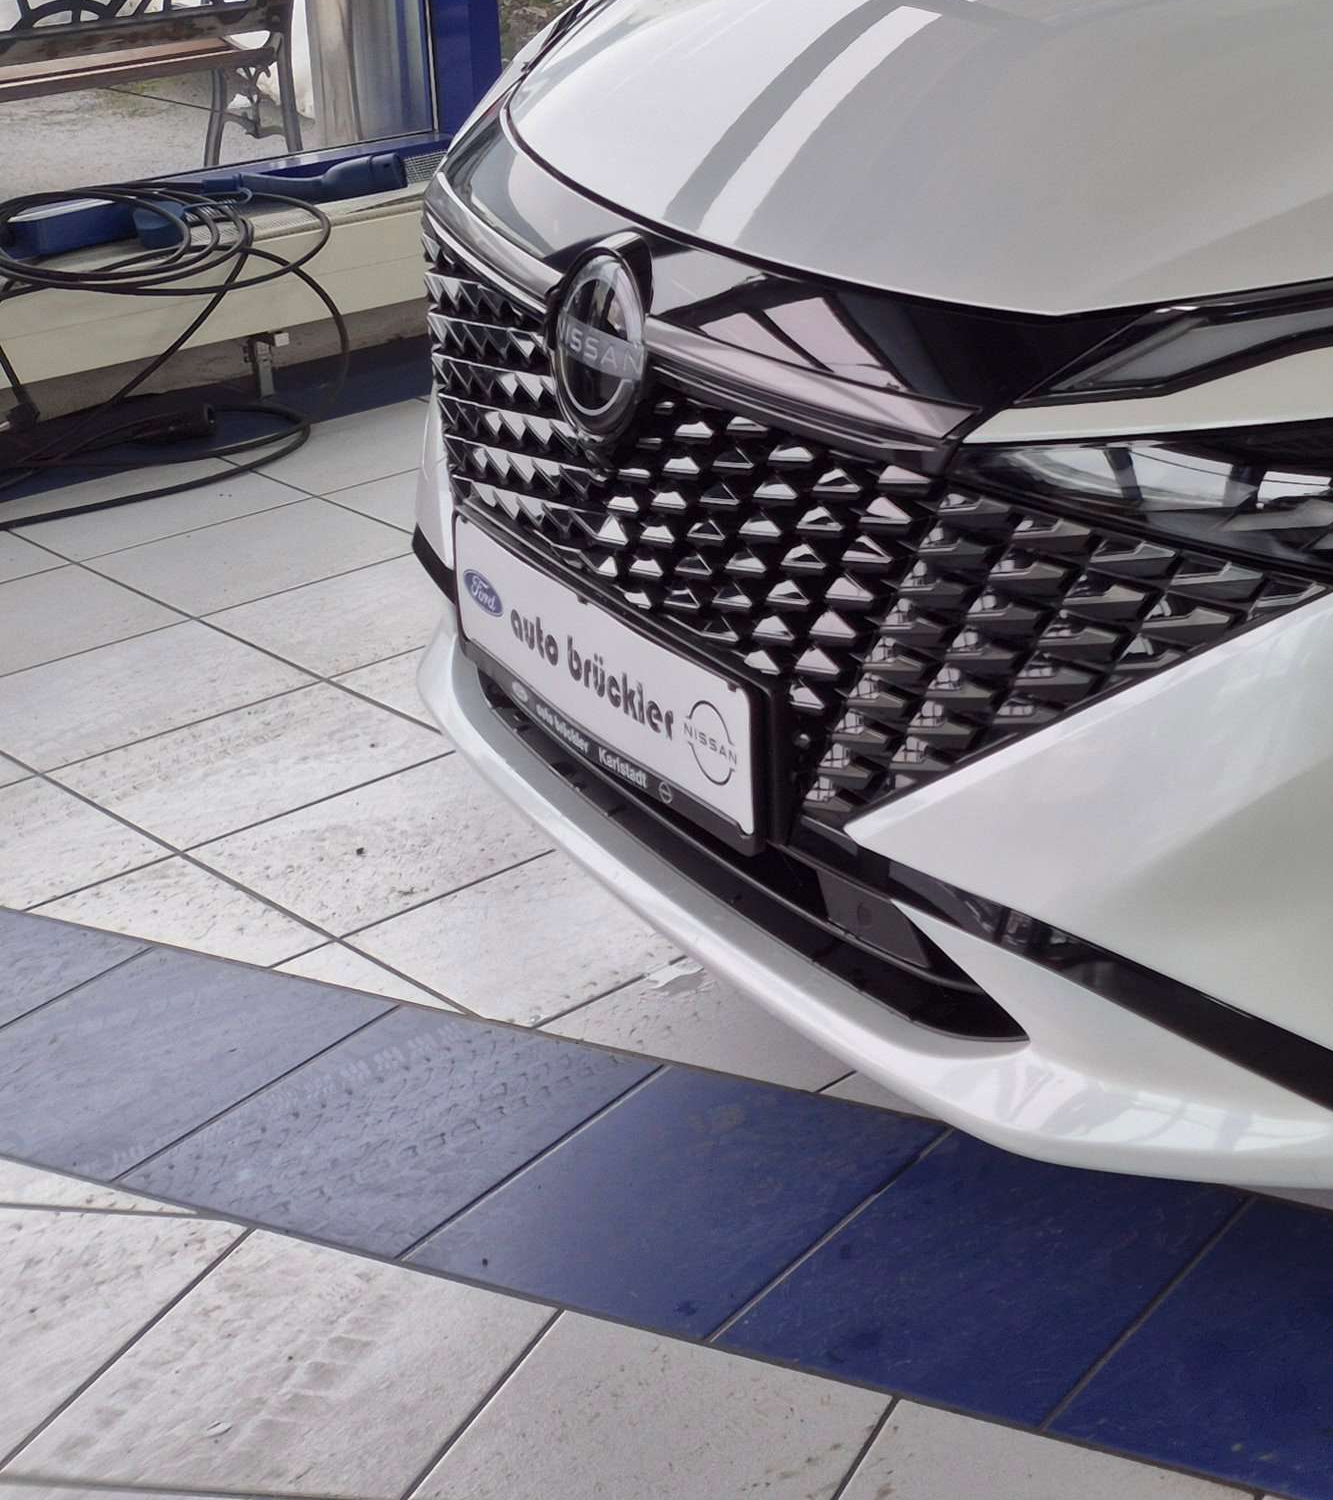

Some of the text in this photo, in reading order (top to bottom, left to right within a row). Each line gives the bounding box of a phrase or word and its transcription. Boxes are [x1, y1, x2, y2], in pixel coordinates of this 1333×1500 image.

[558, 314, 641, 374] NISSAN
[470, 574, 497, 612] Ford
[510, 608, 674, 741] auto brückler
[683, 721, 738, 766] NISSAN
[598, 746, 649, 789] Karlstadt
